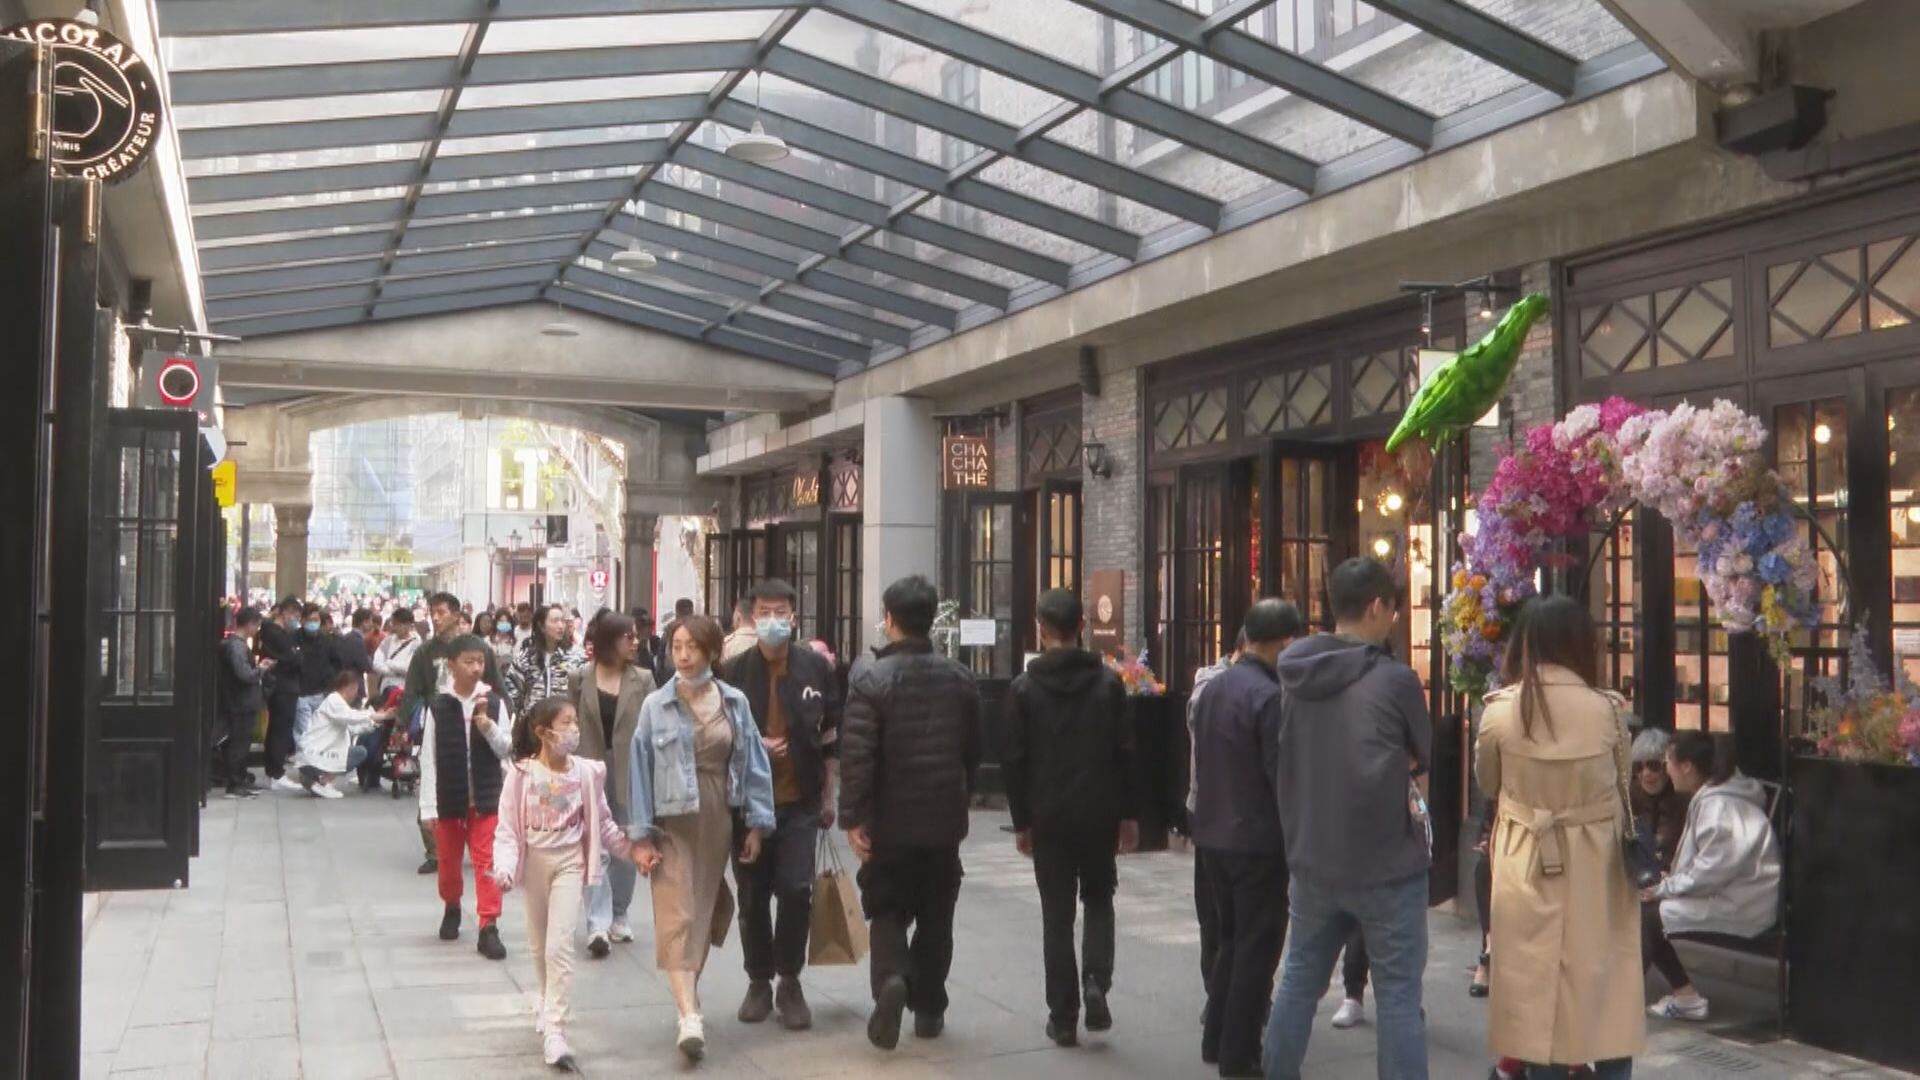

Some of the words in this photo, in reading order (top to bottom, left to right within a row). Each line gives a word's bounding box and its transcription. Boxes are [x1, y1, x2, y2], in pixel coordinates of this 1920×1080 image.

[7, 22, 141, 71] ICOLAI
[951, 442, 988, 457] CHA
[951, 456, 988, 471] CHA
